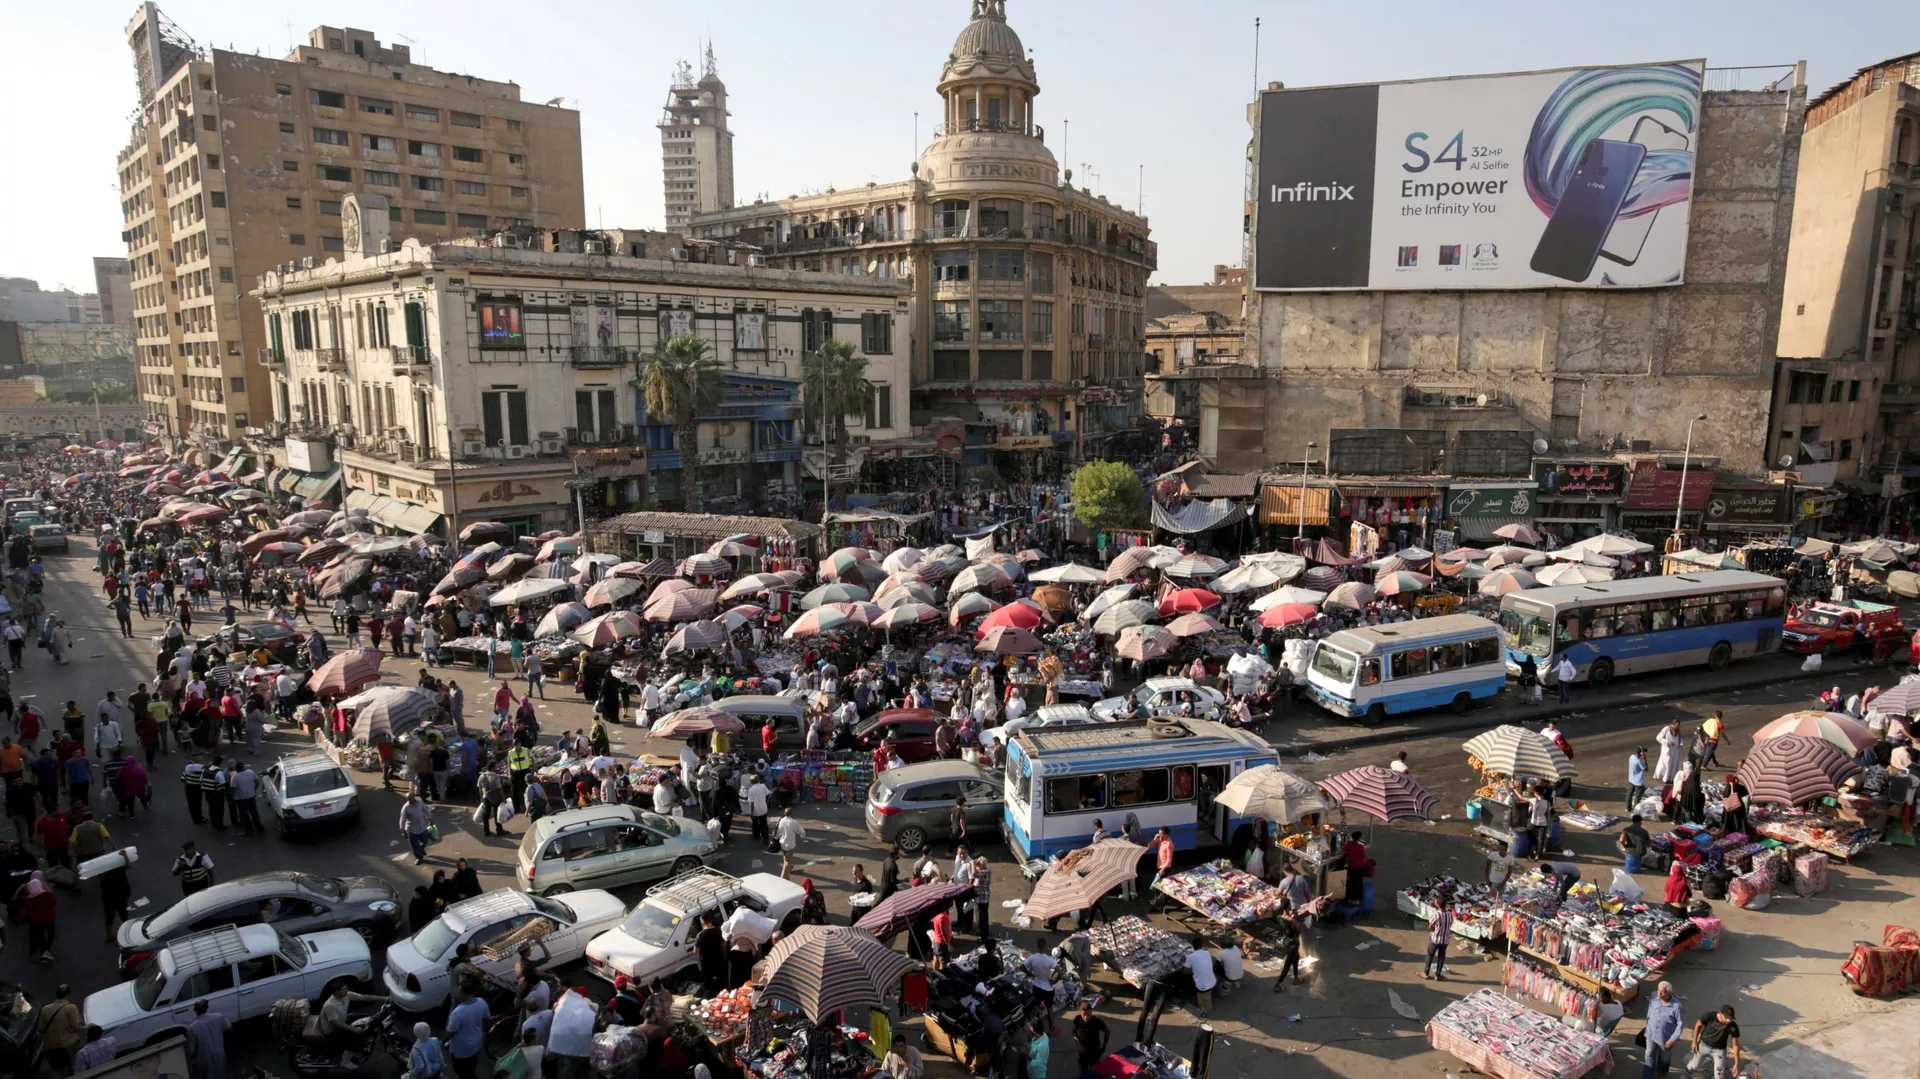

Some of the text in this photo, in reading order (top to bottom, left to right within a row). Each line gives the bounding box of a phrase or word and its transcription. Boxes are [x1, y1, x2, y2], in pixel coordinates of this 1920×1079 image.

[1401, 129, 1467, 173] S4
[1471, 146, 1503, 157] 32MP
[1470, 160, 1509, 170] AI Selfie
[1271, 181, 1355, 202] Infinix
[1401, 178, 1508, 200] Empower
[1401, 202, 1496, 217] the Infinity You
